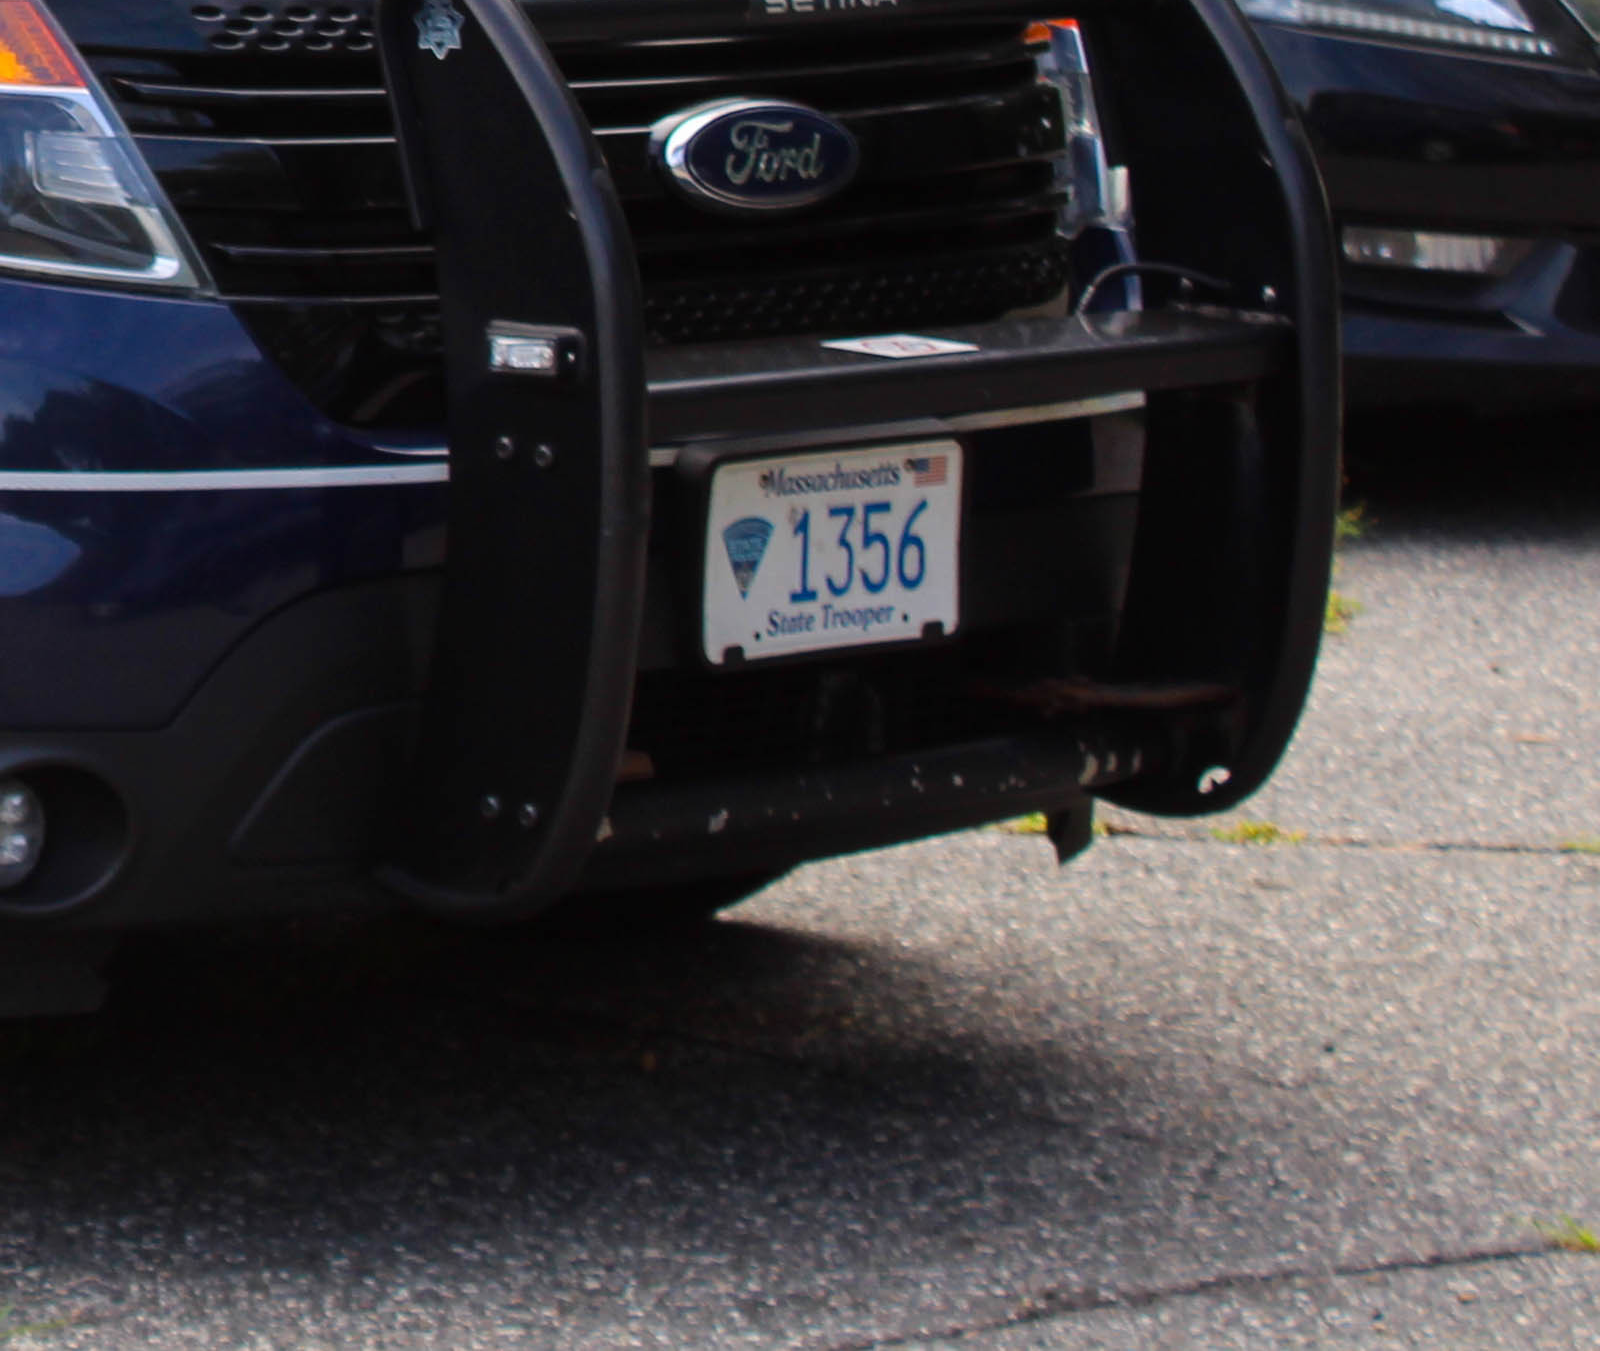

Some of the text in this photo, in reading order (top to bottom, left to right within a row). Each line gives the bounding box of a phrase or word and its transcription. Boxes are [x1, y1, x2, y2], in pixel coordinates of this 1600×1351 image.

[725, 120, 825, 185] Ford
[761, 461, 901, 497] Massachusetts
[788, 498, 929, 604] 1356
[766, 603, 896, 638] State Trooper
